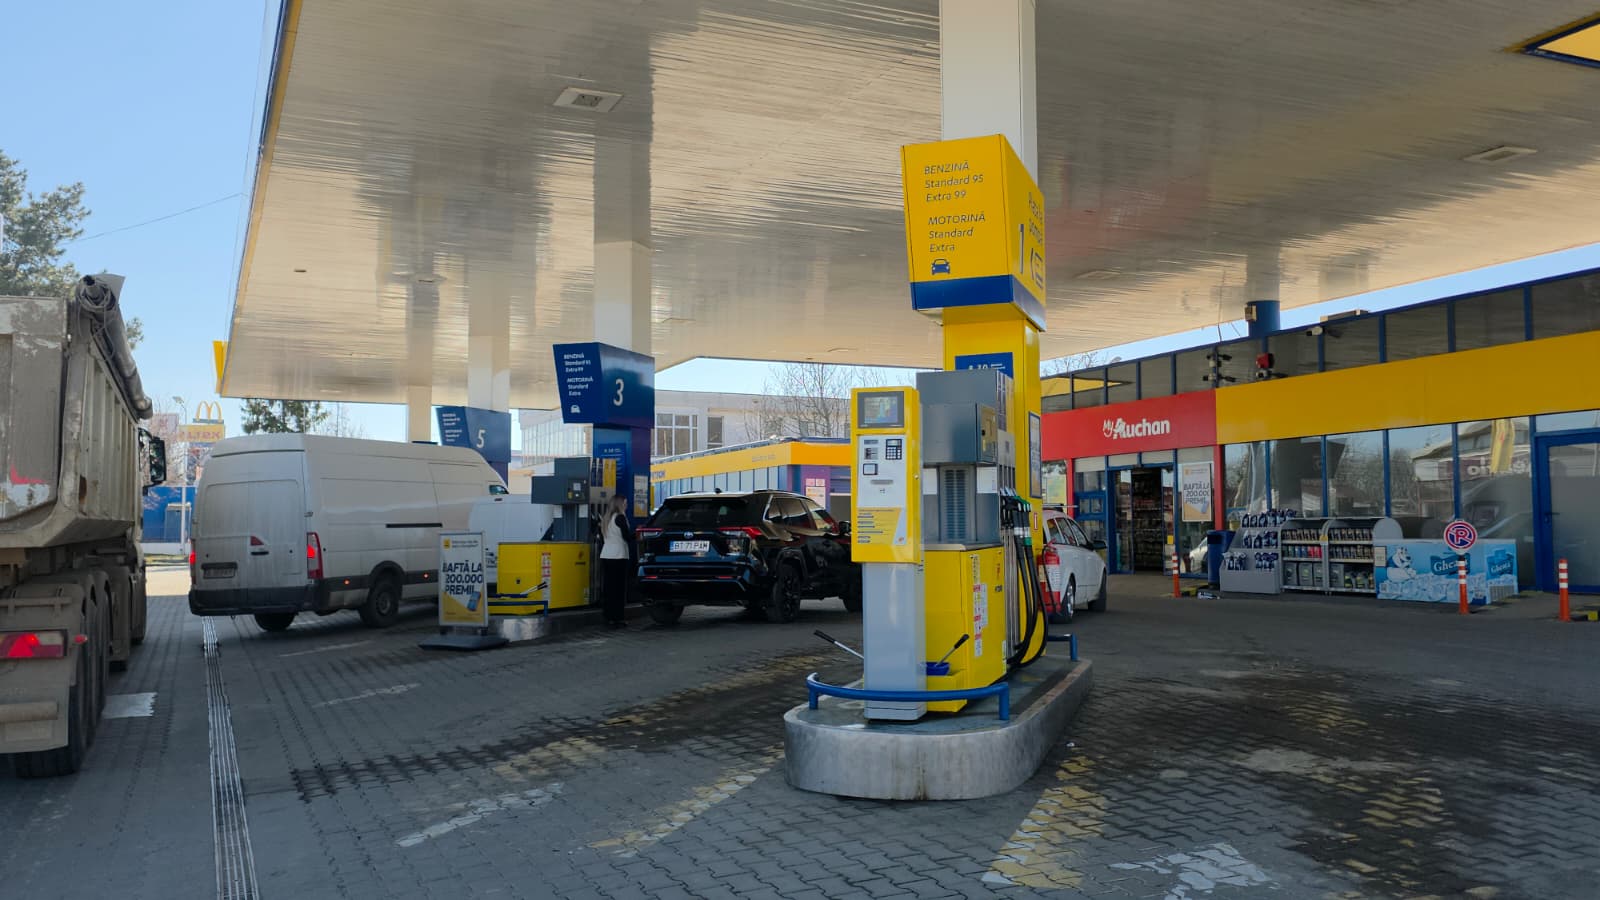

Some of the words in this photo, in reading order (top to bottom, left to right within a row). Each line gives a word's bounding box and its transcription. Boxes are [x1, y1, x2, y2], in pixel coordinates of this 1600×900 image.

[925, 174, 970, 189] Standard
[972, 173, 984, 183] 95
[926, 192, 952, 203] Extra
[954, 190, 967, 199] 99
[929, 226, 974, 239] Standard
[929, 243, 956, 253] Extra
[613, 378, 624, 407] 3
[1113, 417, 1171, 440] Auchan
[476, 429, 486, 449] 5
[445, 573, 484, 584] 200.000
